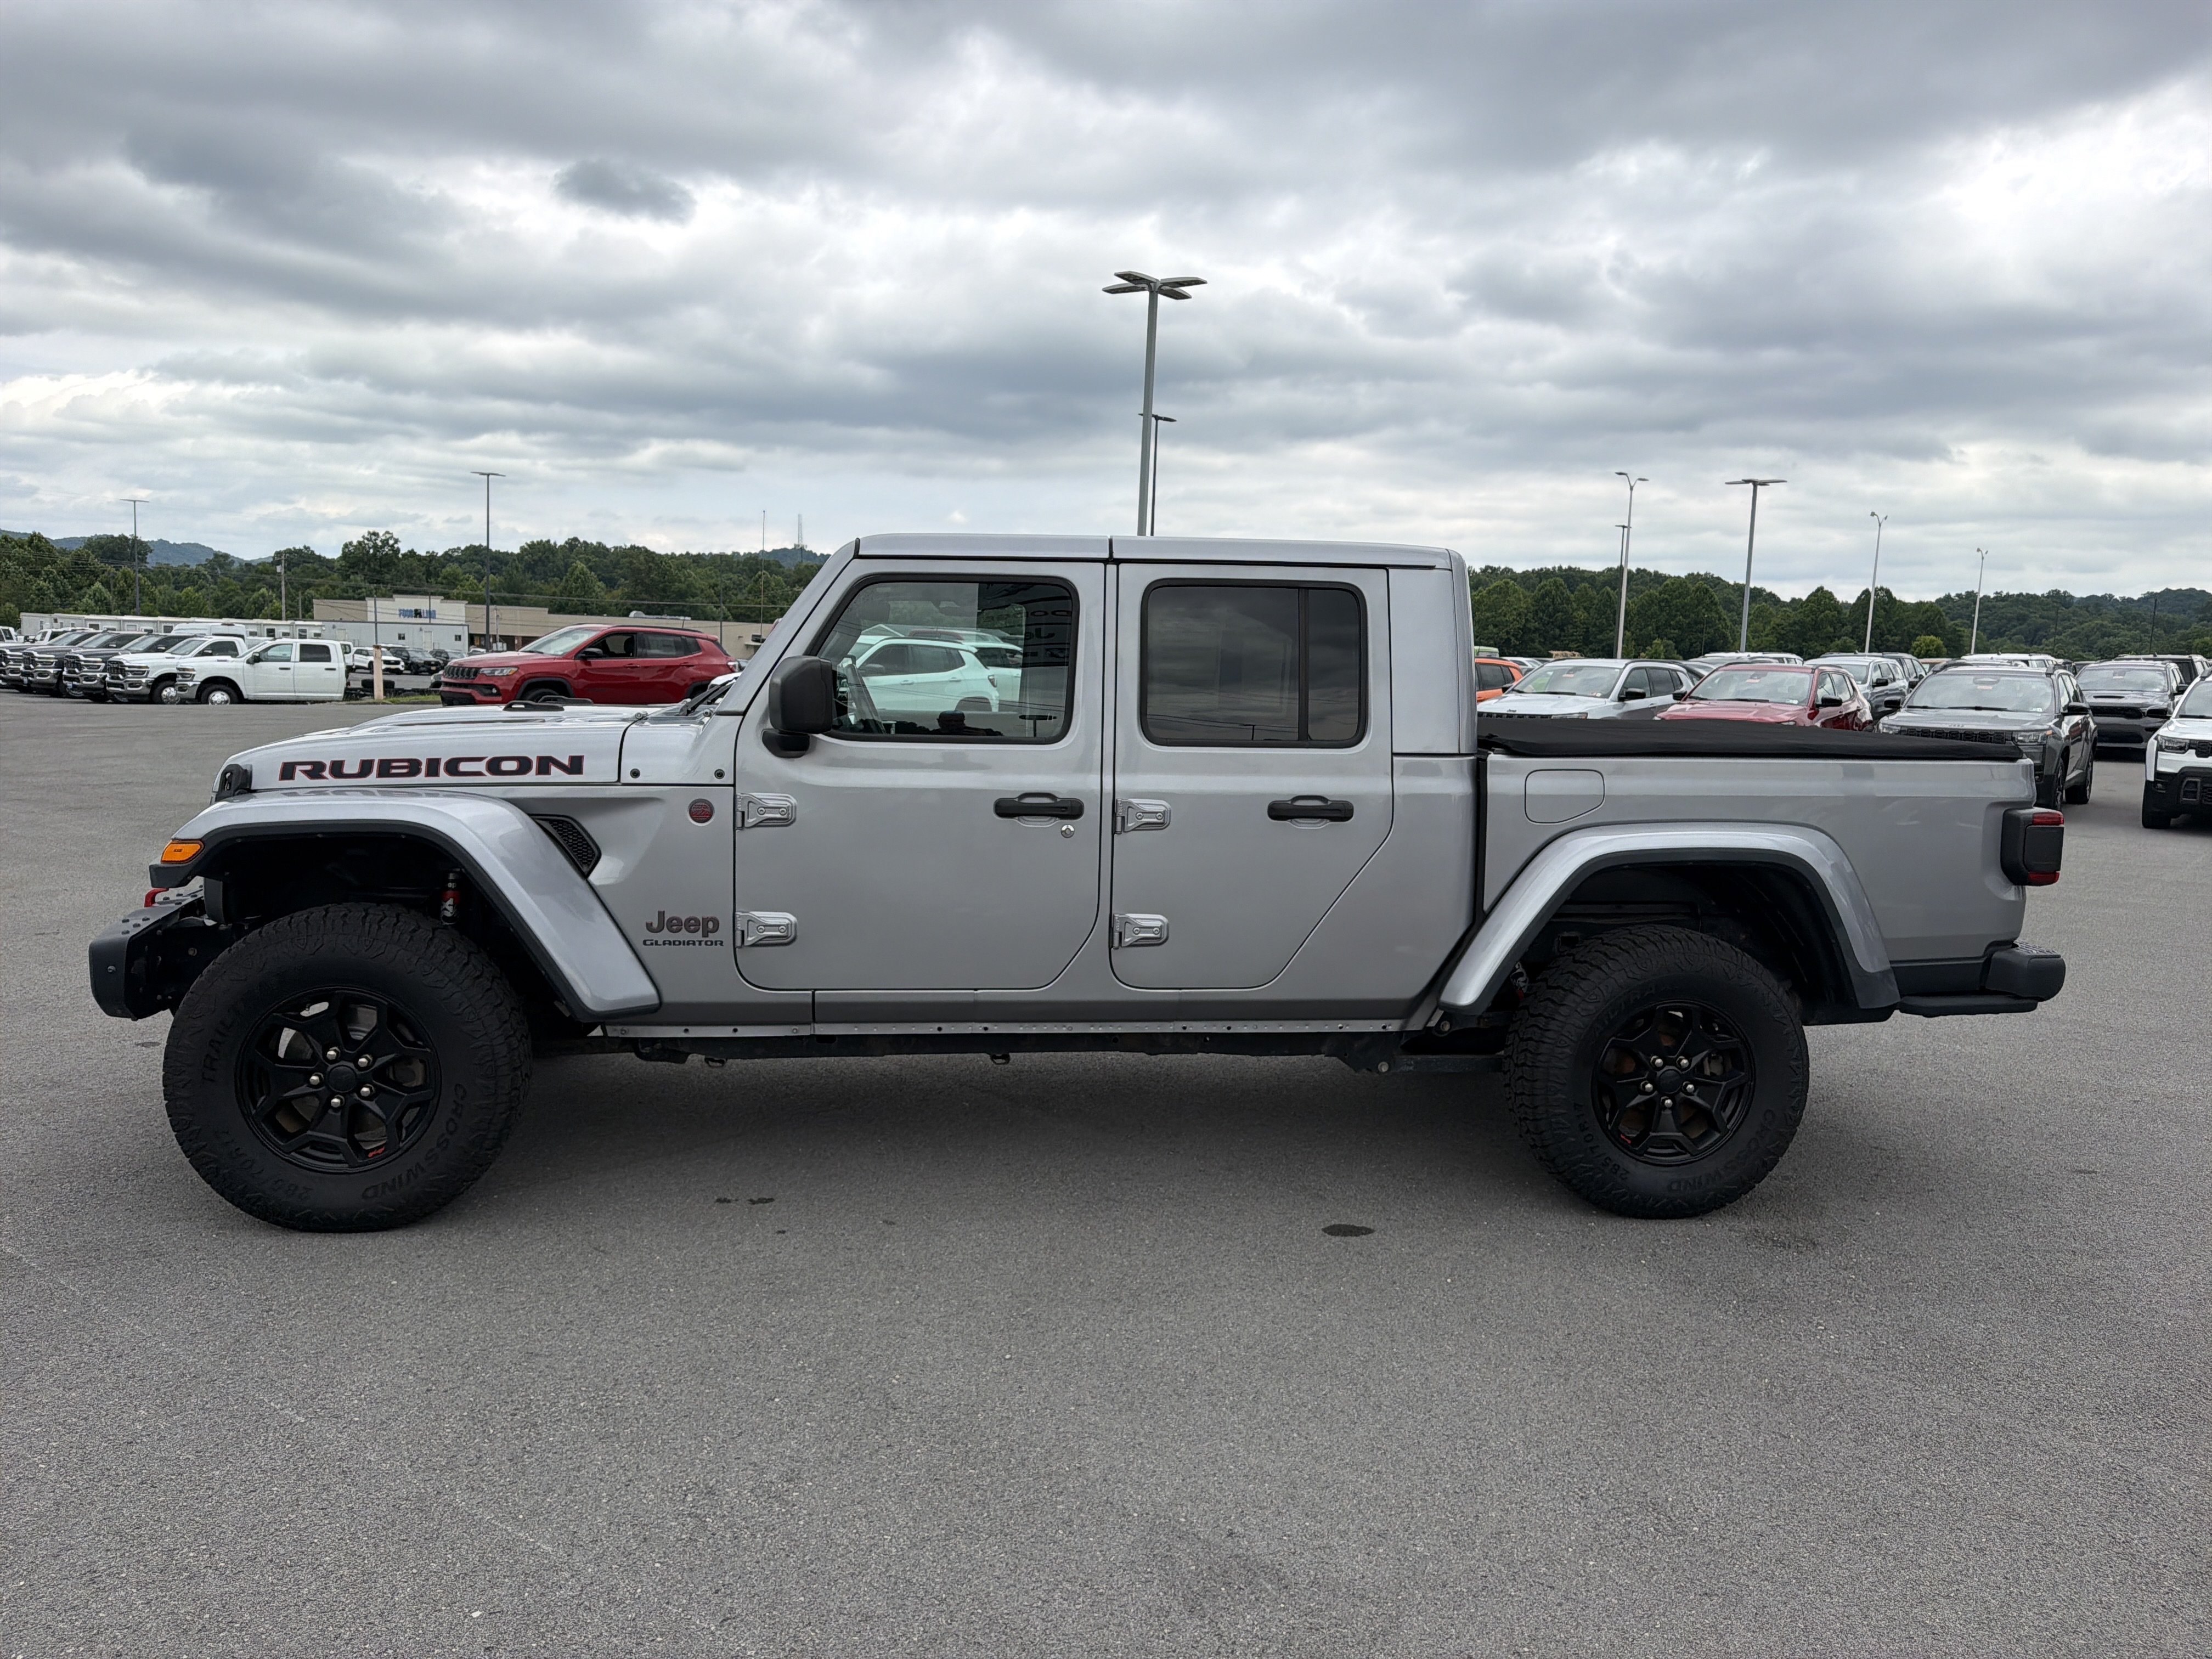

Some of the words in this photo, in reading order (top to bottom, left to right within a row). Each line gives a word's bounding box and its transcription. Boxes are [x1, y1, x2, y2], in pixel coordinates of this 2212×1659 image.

[279, 755, 585, 781] RUBICON
[645, 910, 720, 938] Jeep
[642, 939, 724, 947] GLADIATOR
[362, 1083, 466, 1199] CROSSWIND
[1573, 1102, 1630, 1180] 285/70R17
